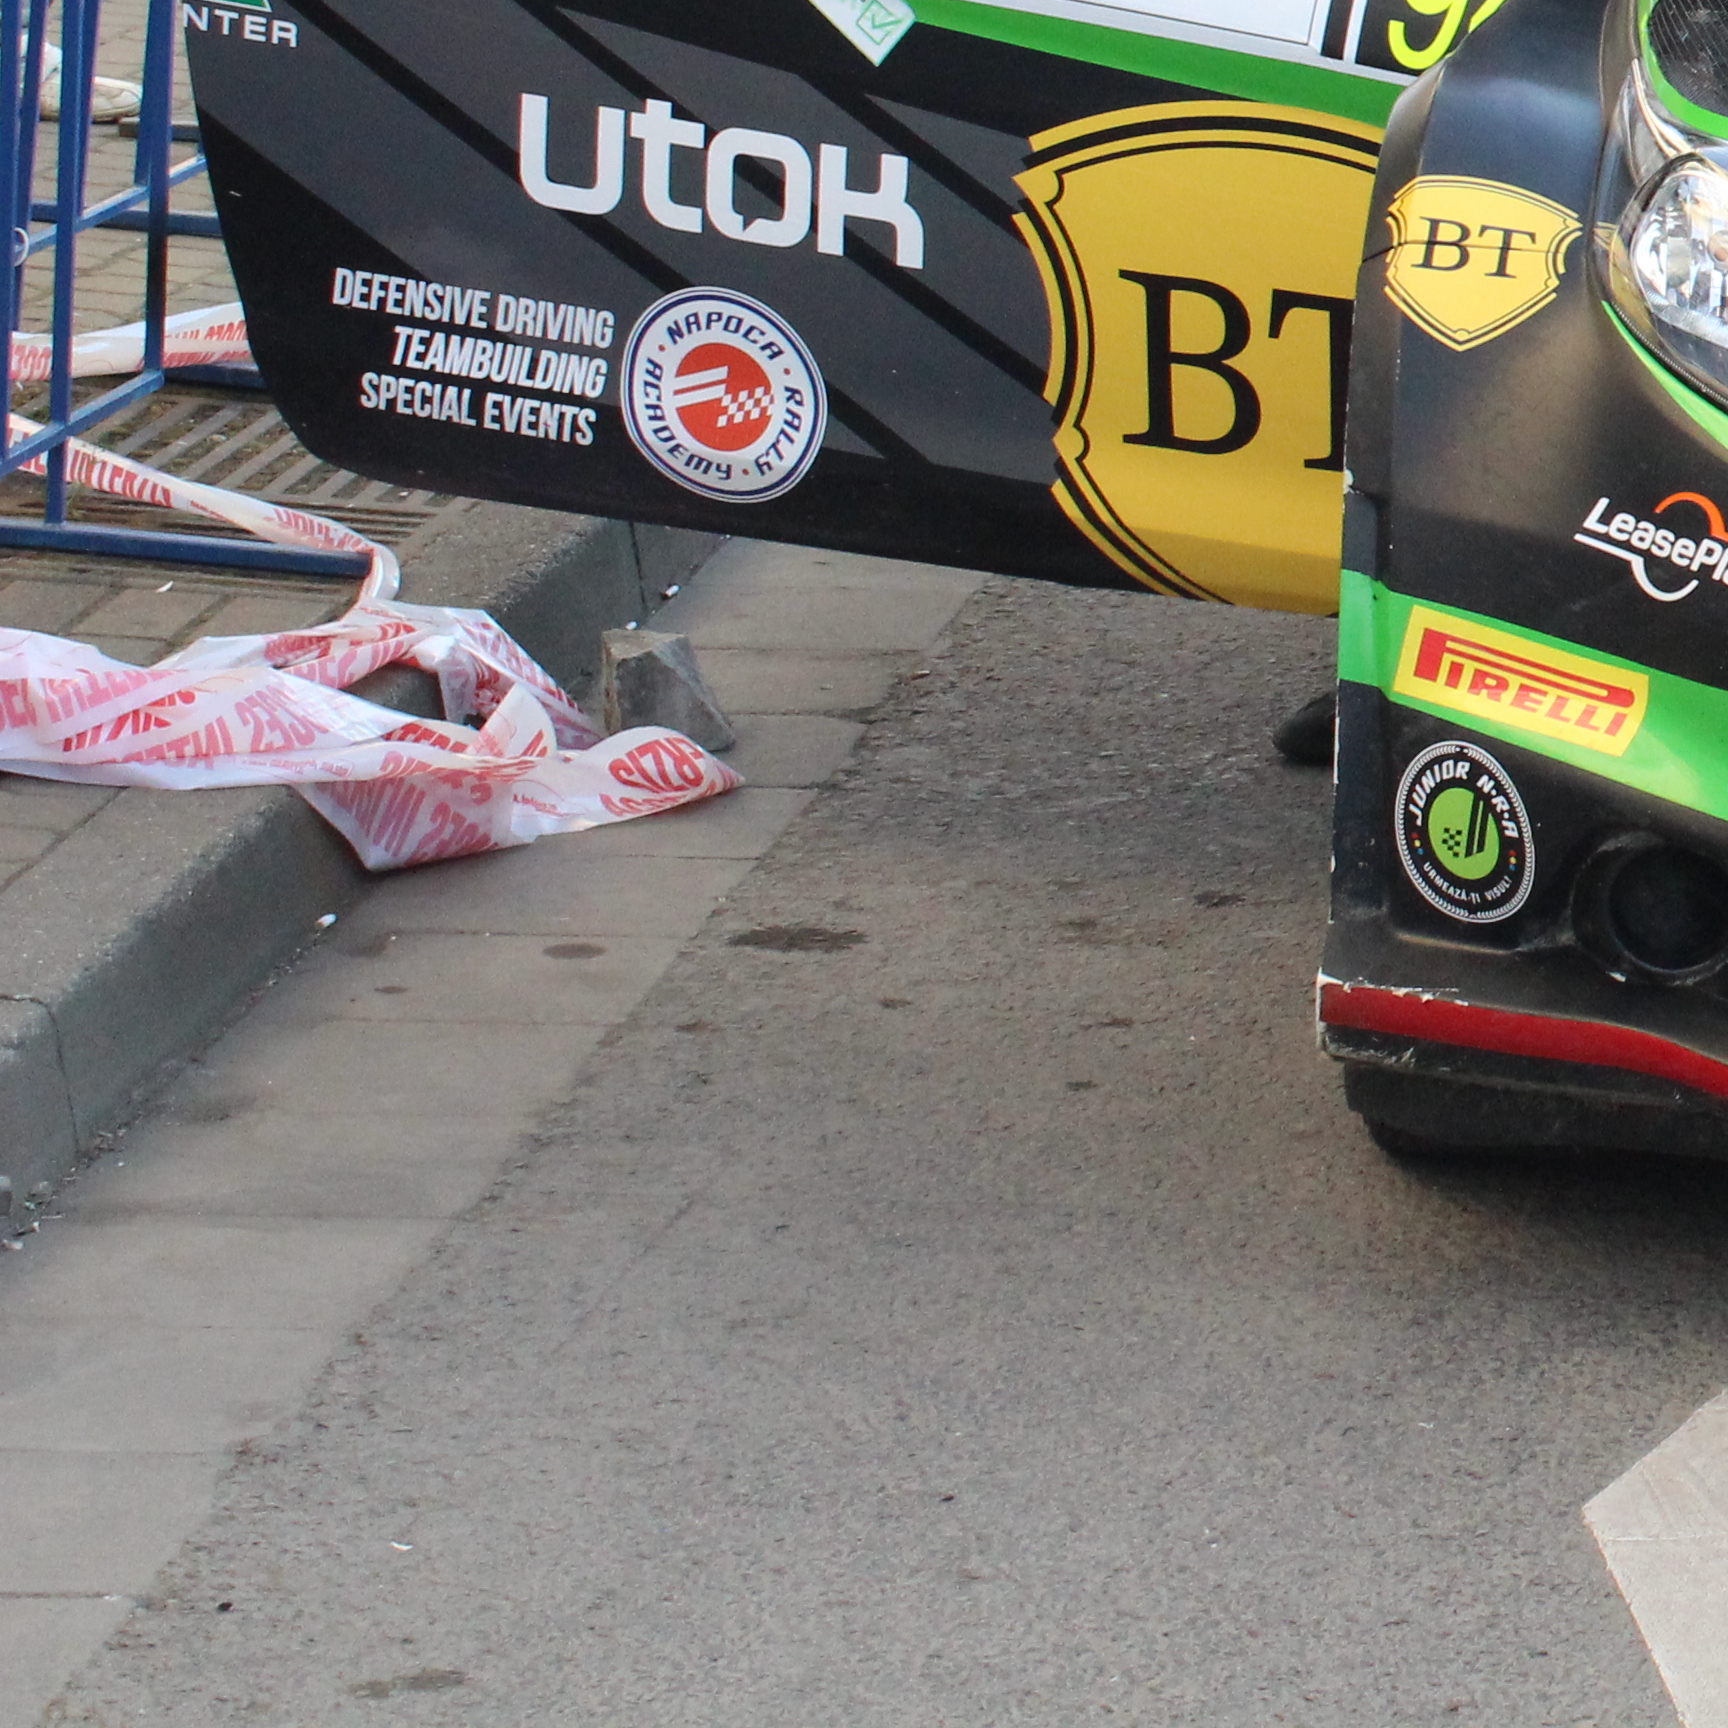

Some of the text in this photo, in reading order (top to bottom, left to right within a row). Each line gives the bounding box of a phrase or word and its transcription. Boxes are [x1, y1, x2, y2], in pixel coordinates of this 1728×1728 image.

[183, 3, 298, 48] NTER
[1410, 215, 1537, 279] BT
[332, 267, 616, 350] DEFENSIVE DRIVING
[392, 326, 608, 400] TEAMBUILDING
[666, 311, 805, 476] NAPOCA RALLY
[1118, 268, 1356, 475] BT
[360, 373, 597, 447] SPECIAL EVENTS
[642, 358, 733, 481] ACADEMY
[1413, 628, 1636, 738] PIRELLI
[1408, 759, 1471, 827] JUNIOR
